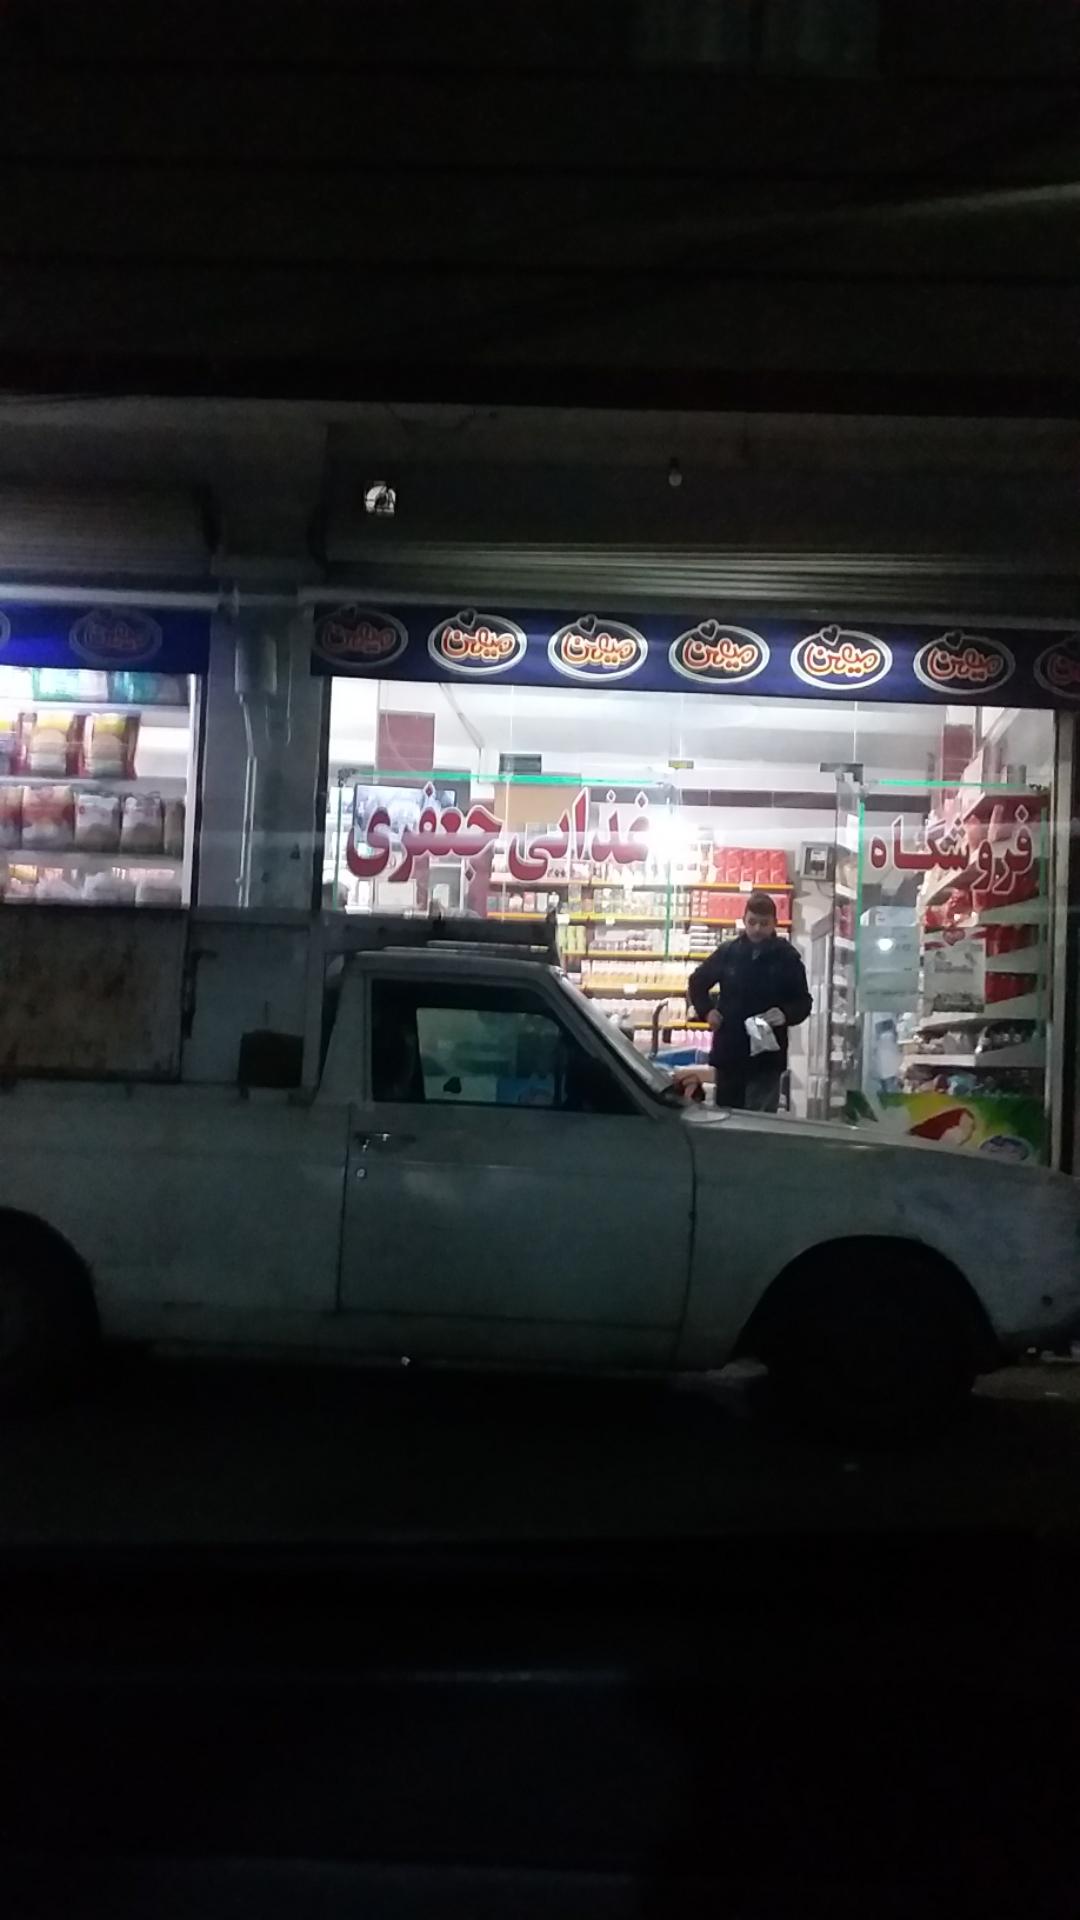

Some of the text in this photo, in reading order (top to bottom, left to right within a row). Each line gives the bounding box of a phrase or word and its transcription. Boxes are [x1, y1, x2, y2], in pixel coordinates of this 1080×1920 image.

[443, 626, 516, 660] میهن
[561, 629, 634, 664] میهن
[683, 635, 756, 669] میهن
[806, 642, 878, 677] میهن
[928, 645, 1001, 679] میهن
[346, 781, 1034, 895] فروشگاه غذایی جعفری
